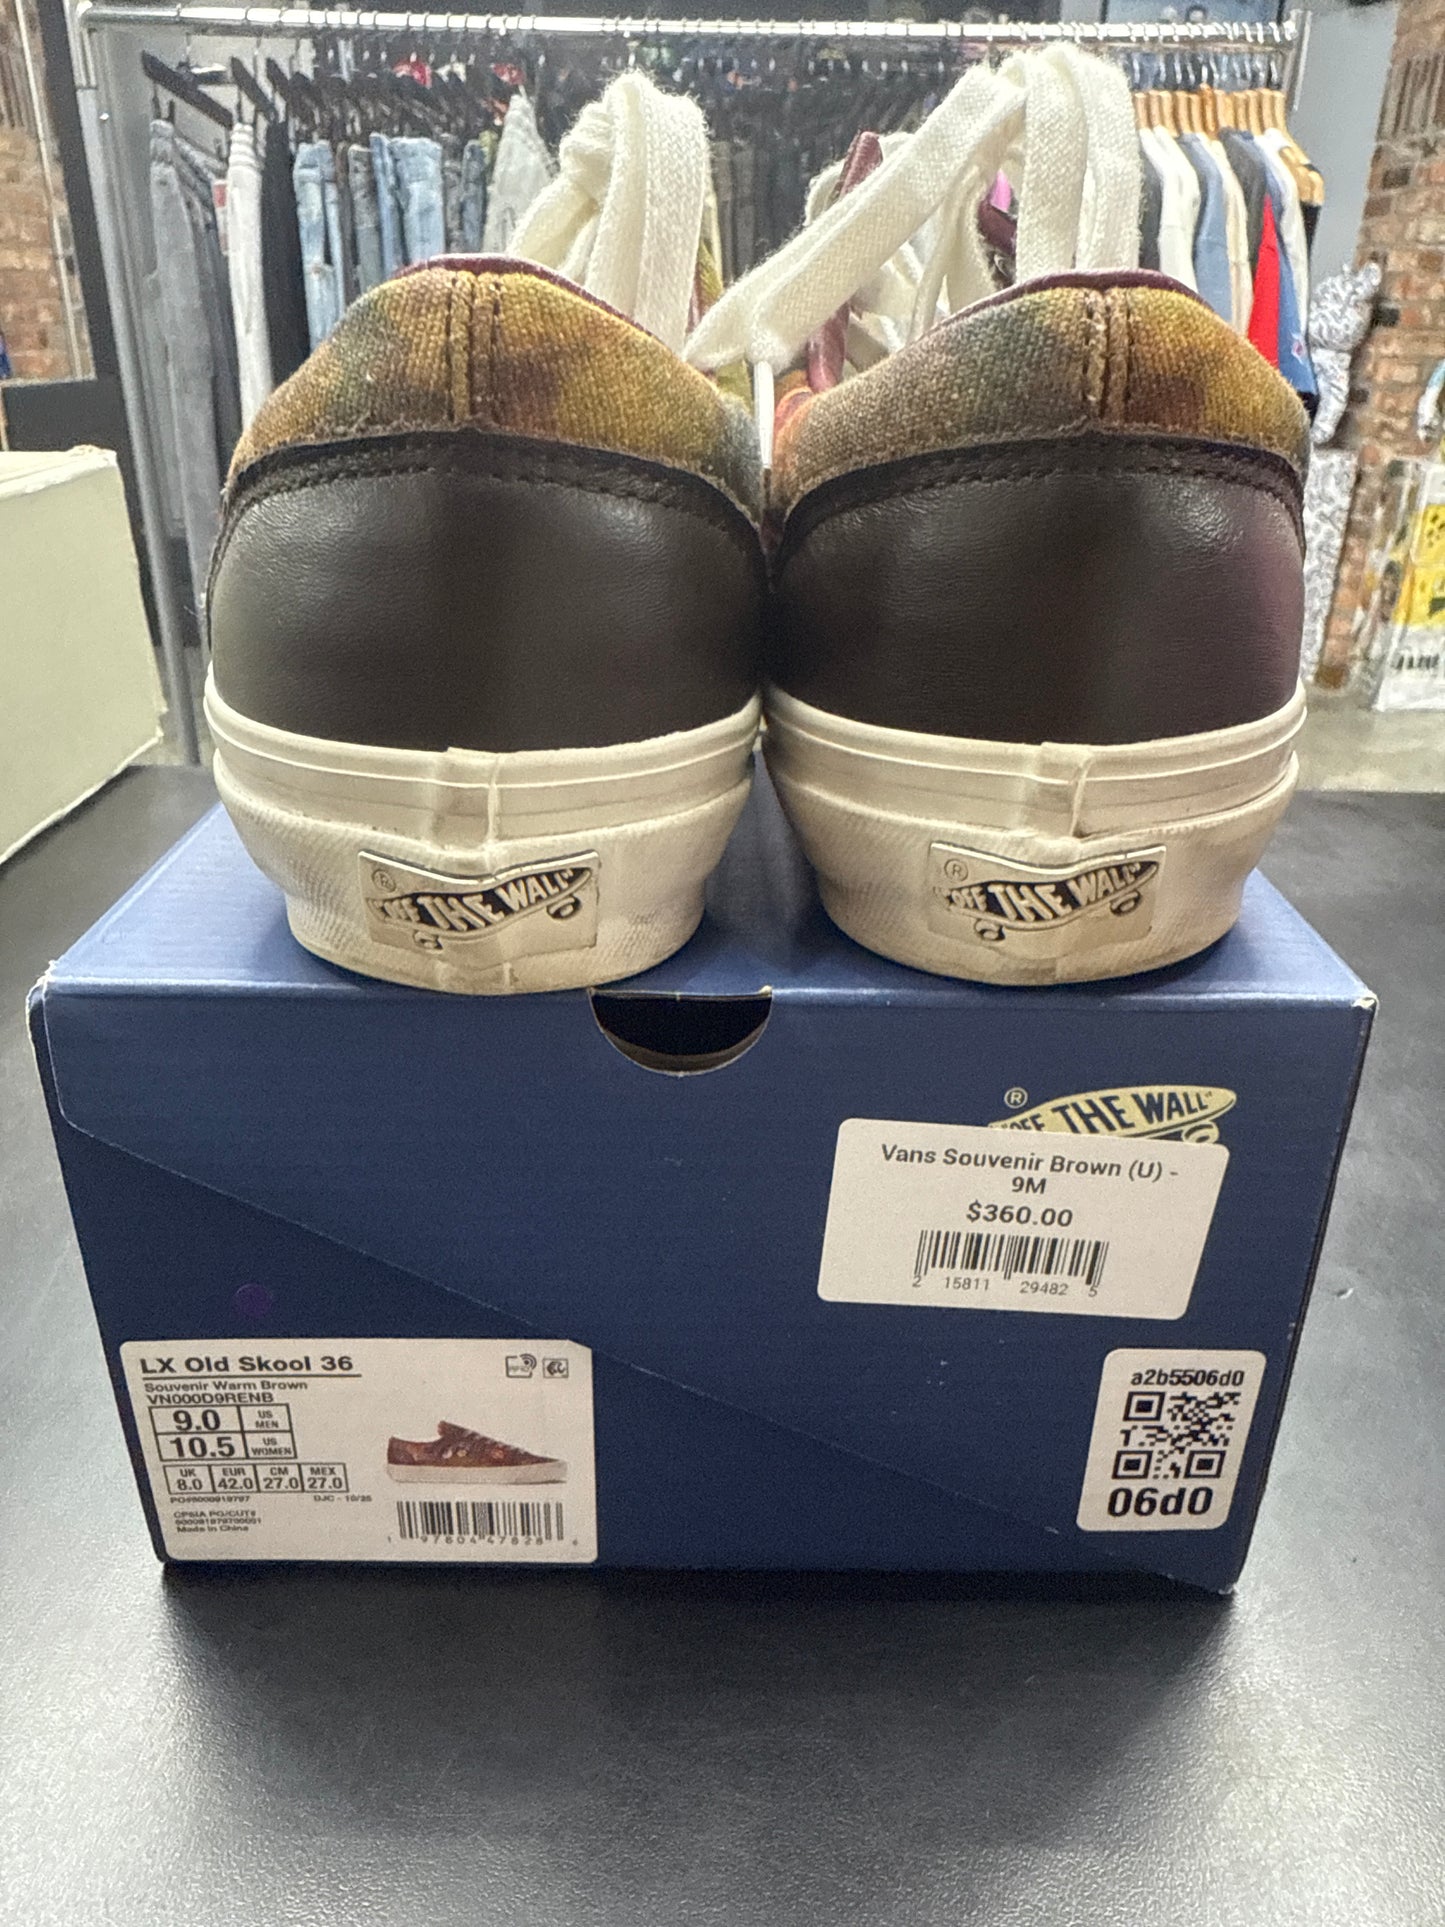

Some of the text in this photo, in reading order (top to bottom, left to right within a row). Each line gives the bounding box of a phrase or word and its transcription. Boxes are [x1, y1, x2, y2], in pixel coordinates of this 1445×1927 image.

[987, 883, 1072, 922] THE
[416, 894, 504, 931] THE
[1051, 1095, 1135, 1134] THE
[881, 1143, 937, 1164] Vans
[942, 1148, 1044, 1172] Souvenir
[1050, 1155, 1121, 1177] Brown
[1128, 1159, 1163, 1182] (U)
[1011, 1176, 1047, 1195] 9M
[966, 1199, 1073, 1227] $360.00
[912, 1275, 1098, 1298] 2 15811 29482 5
[140, 1356, 353, 1374] LX Old Skool 36
[144, 1380, 308, 1393] Souvenir Warm Brown
[1131, 1369, 1245, 1386] a2b5506d0
[172, 1409, 221, 1432] 9.0
[257, 1410, 273, 1419] US
[255, 1420, 279, 1429] MEN
[170, 1436, 236, 1458] 10.5
[251, 1447, 292, 1456] WOMEN
[262, 1438, 277, 1446] US
[180, 1467, 336, 1478] UK EUR CM MEX
[177, 1477, 343, 1491] 8.0 42.0 27.0 27.0
[1107, 1486, 1214, 1517] 06d0
